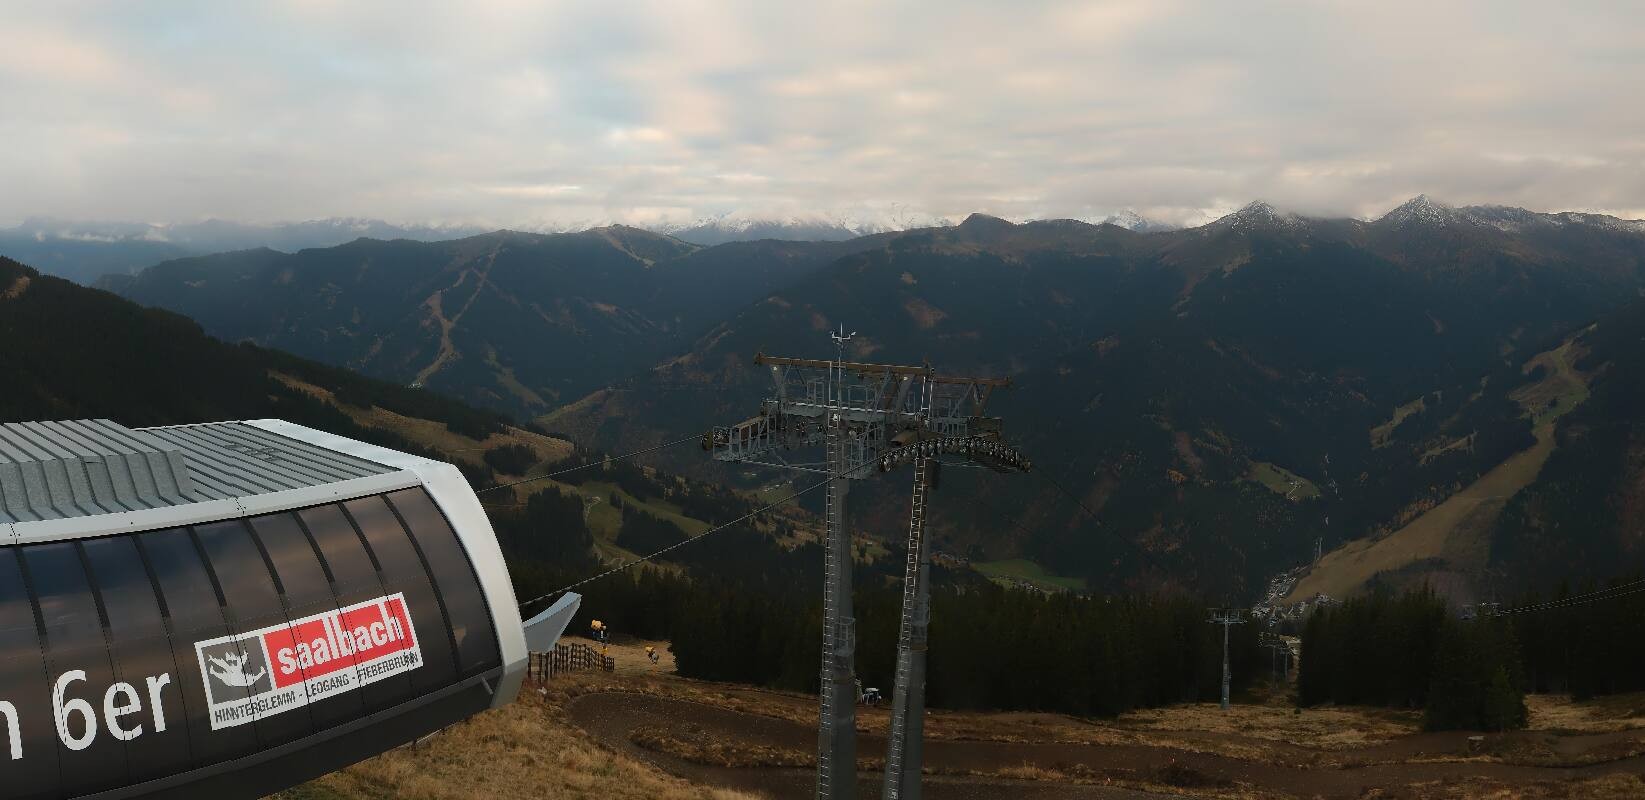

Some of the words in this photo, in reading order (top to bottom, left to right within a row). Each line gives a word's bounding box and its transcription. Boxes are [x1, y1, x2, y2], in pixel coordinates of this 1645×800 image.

[277, 604, 405, 676] saalbach
[52, 669, 171, 751] 6er
[305, 673, 350, 698] LEOGANG
